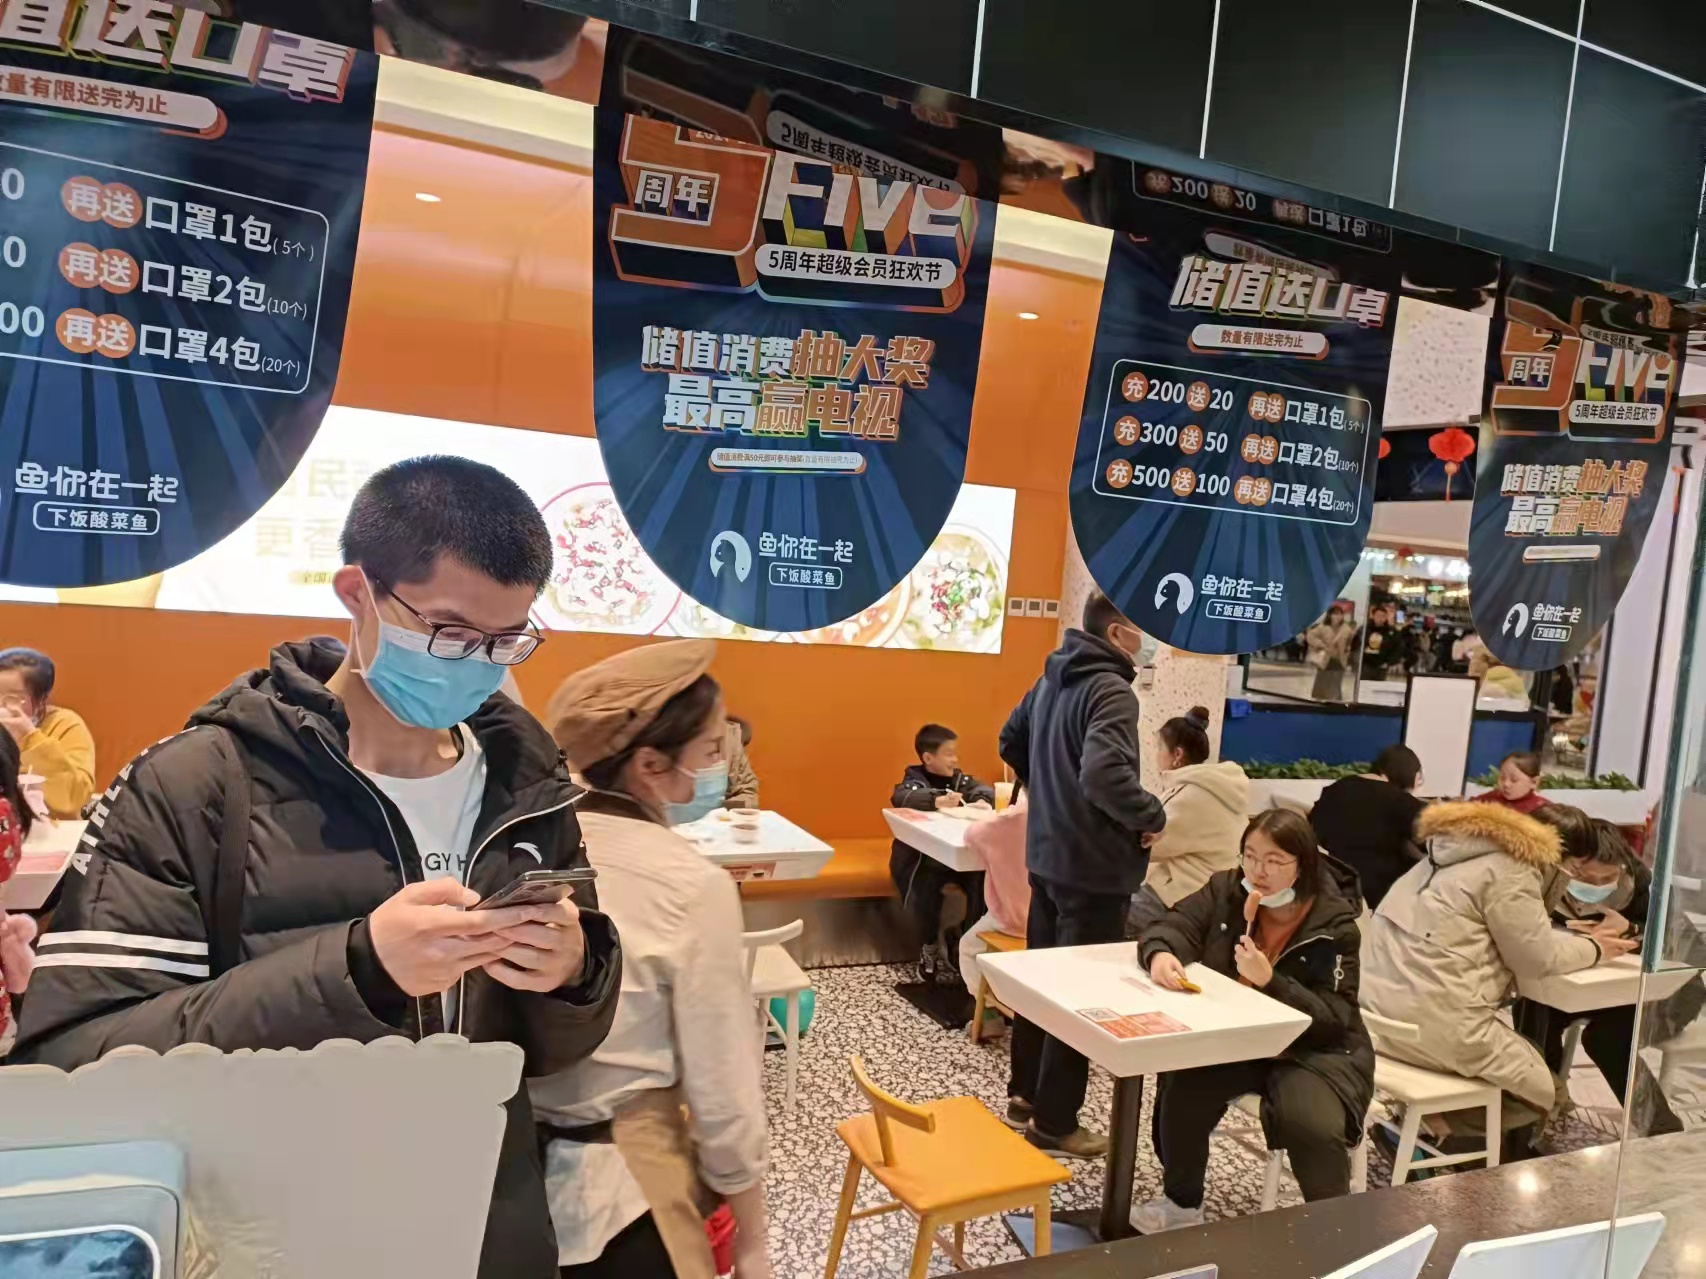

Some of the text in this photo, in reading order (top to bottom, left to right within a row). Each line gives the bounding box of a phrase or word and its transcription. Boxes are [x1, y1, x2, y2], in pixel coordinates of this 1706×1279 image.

[634, 169, 714, 214] 周年
[768, 250, 943, 283] 5周年超级会员狂欢节
[1219, 328, 1304, 349] 数量有限送完为止
[642, 325, 935, 389] 储值消费抽大奖
[664, 373, 902, 442] 最高赢电视
[1575, 403, 1658, 422] 5周年超级会员狂欢节
[14, 461, 179, 503] 鱼你在一起
[47, 507, 149, 532] 下饭酸菜鱼
[758, 531, 854, 564] 鱼你在一起
[775, 567, 837, 586] 下饭酸菜鱼
[1200, 573, 1284, 602] 鱼你在一起
[1213, 603, 1265, 619] 下饭酸菜鱼
[425, 852, 452, 871] GY
